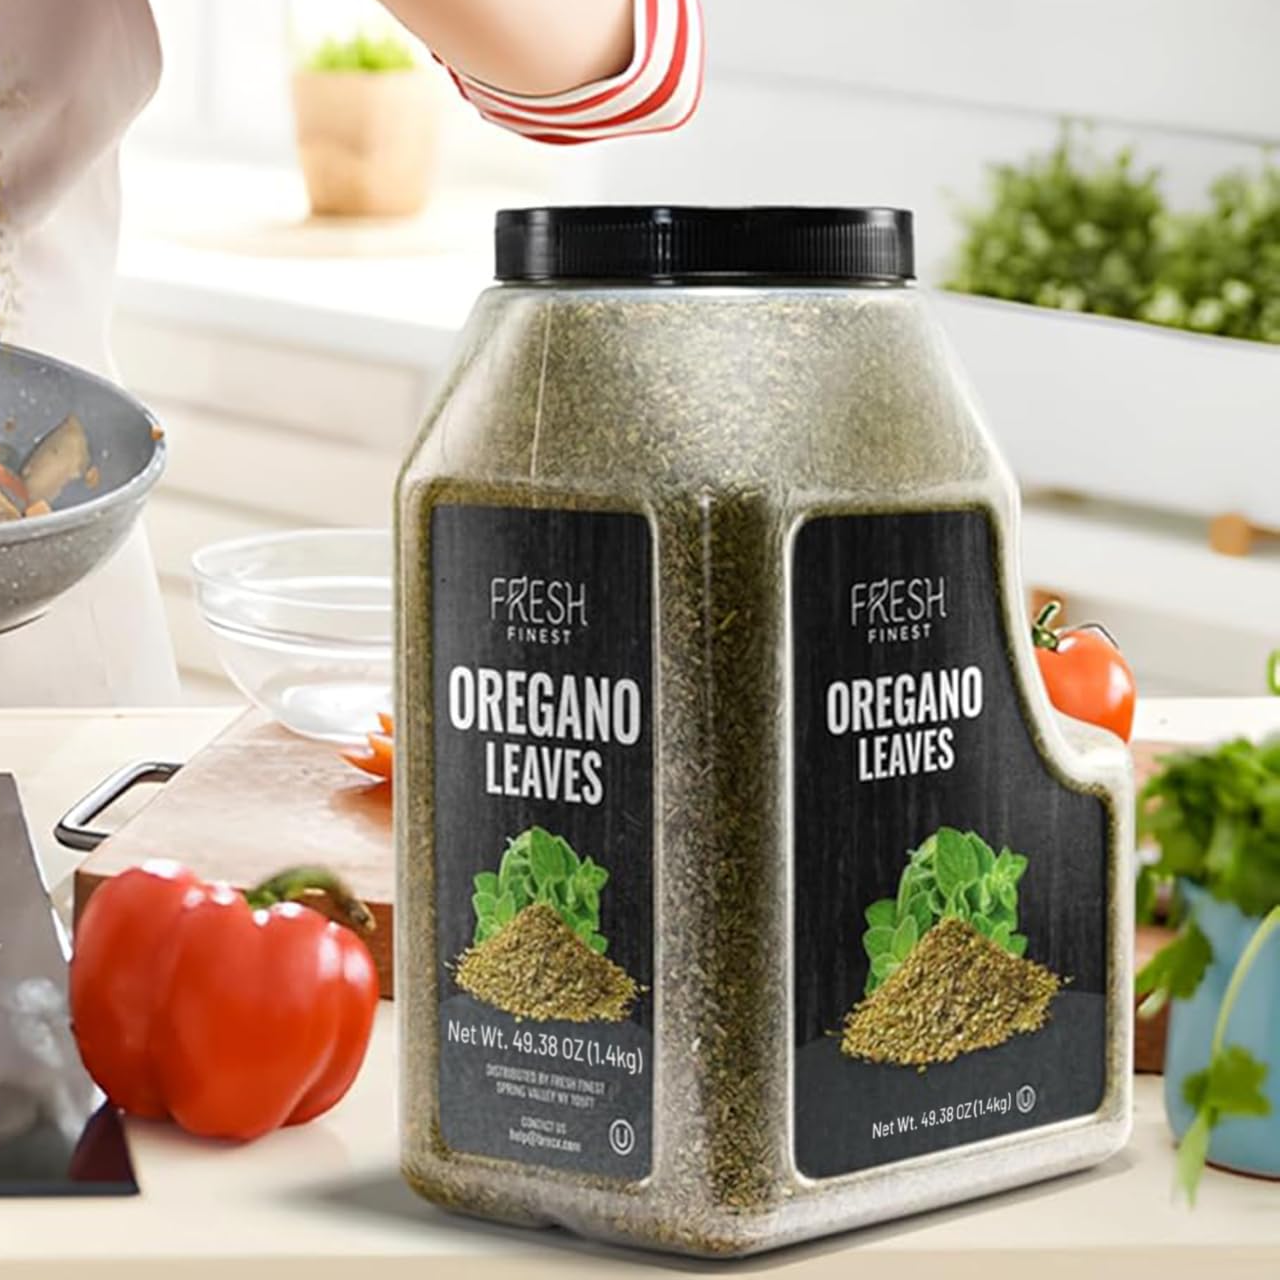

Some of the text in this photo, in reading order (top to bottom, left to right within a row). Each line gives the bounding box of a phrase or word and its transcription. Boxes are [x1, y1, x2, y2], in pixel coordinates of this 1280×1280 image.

[490, 576, 588, 626] FRESH
[851, 576, 947, 626] FRESH
[507, 626, 571, 644] FINEST
[868, 623, 931, 644] FINEST
[448, 665, 641, 746] OREGANO
[827, 666, 983, 735] OREGANO
[486, 741, 603, 805] LEAVES
[859, 726, 955, 781] LEAVES
[447, 1019, 477, 1045] Net
[481, 1025, 508, 1050] Wt.
[512, 1030, 558, 1057] 49.38
[496, 1081, 526, 1098] SPRING
[528, 1087, 556, 1103] VALLEY
[538, 1072, 550, 1086] BY
[872, 1122, 894, 1139] Net
[897, 1117, 918, 1133] Wt.
[921, 1106, 954, 1128] 49.38
